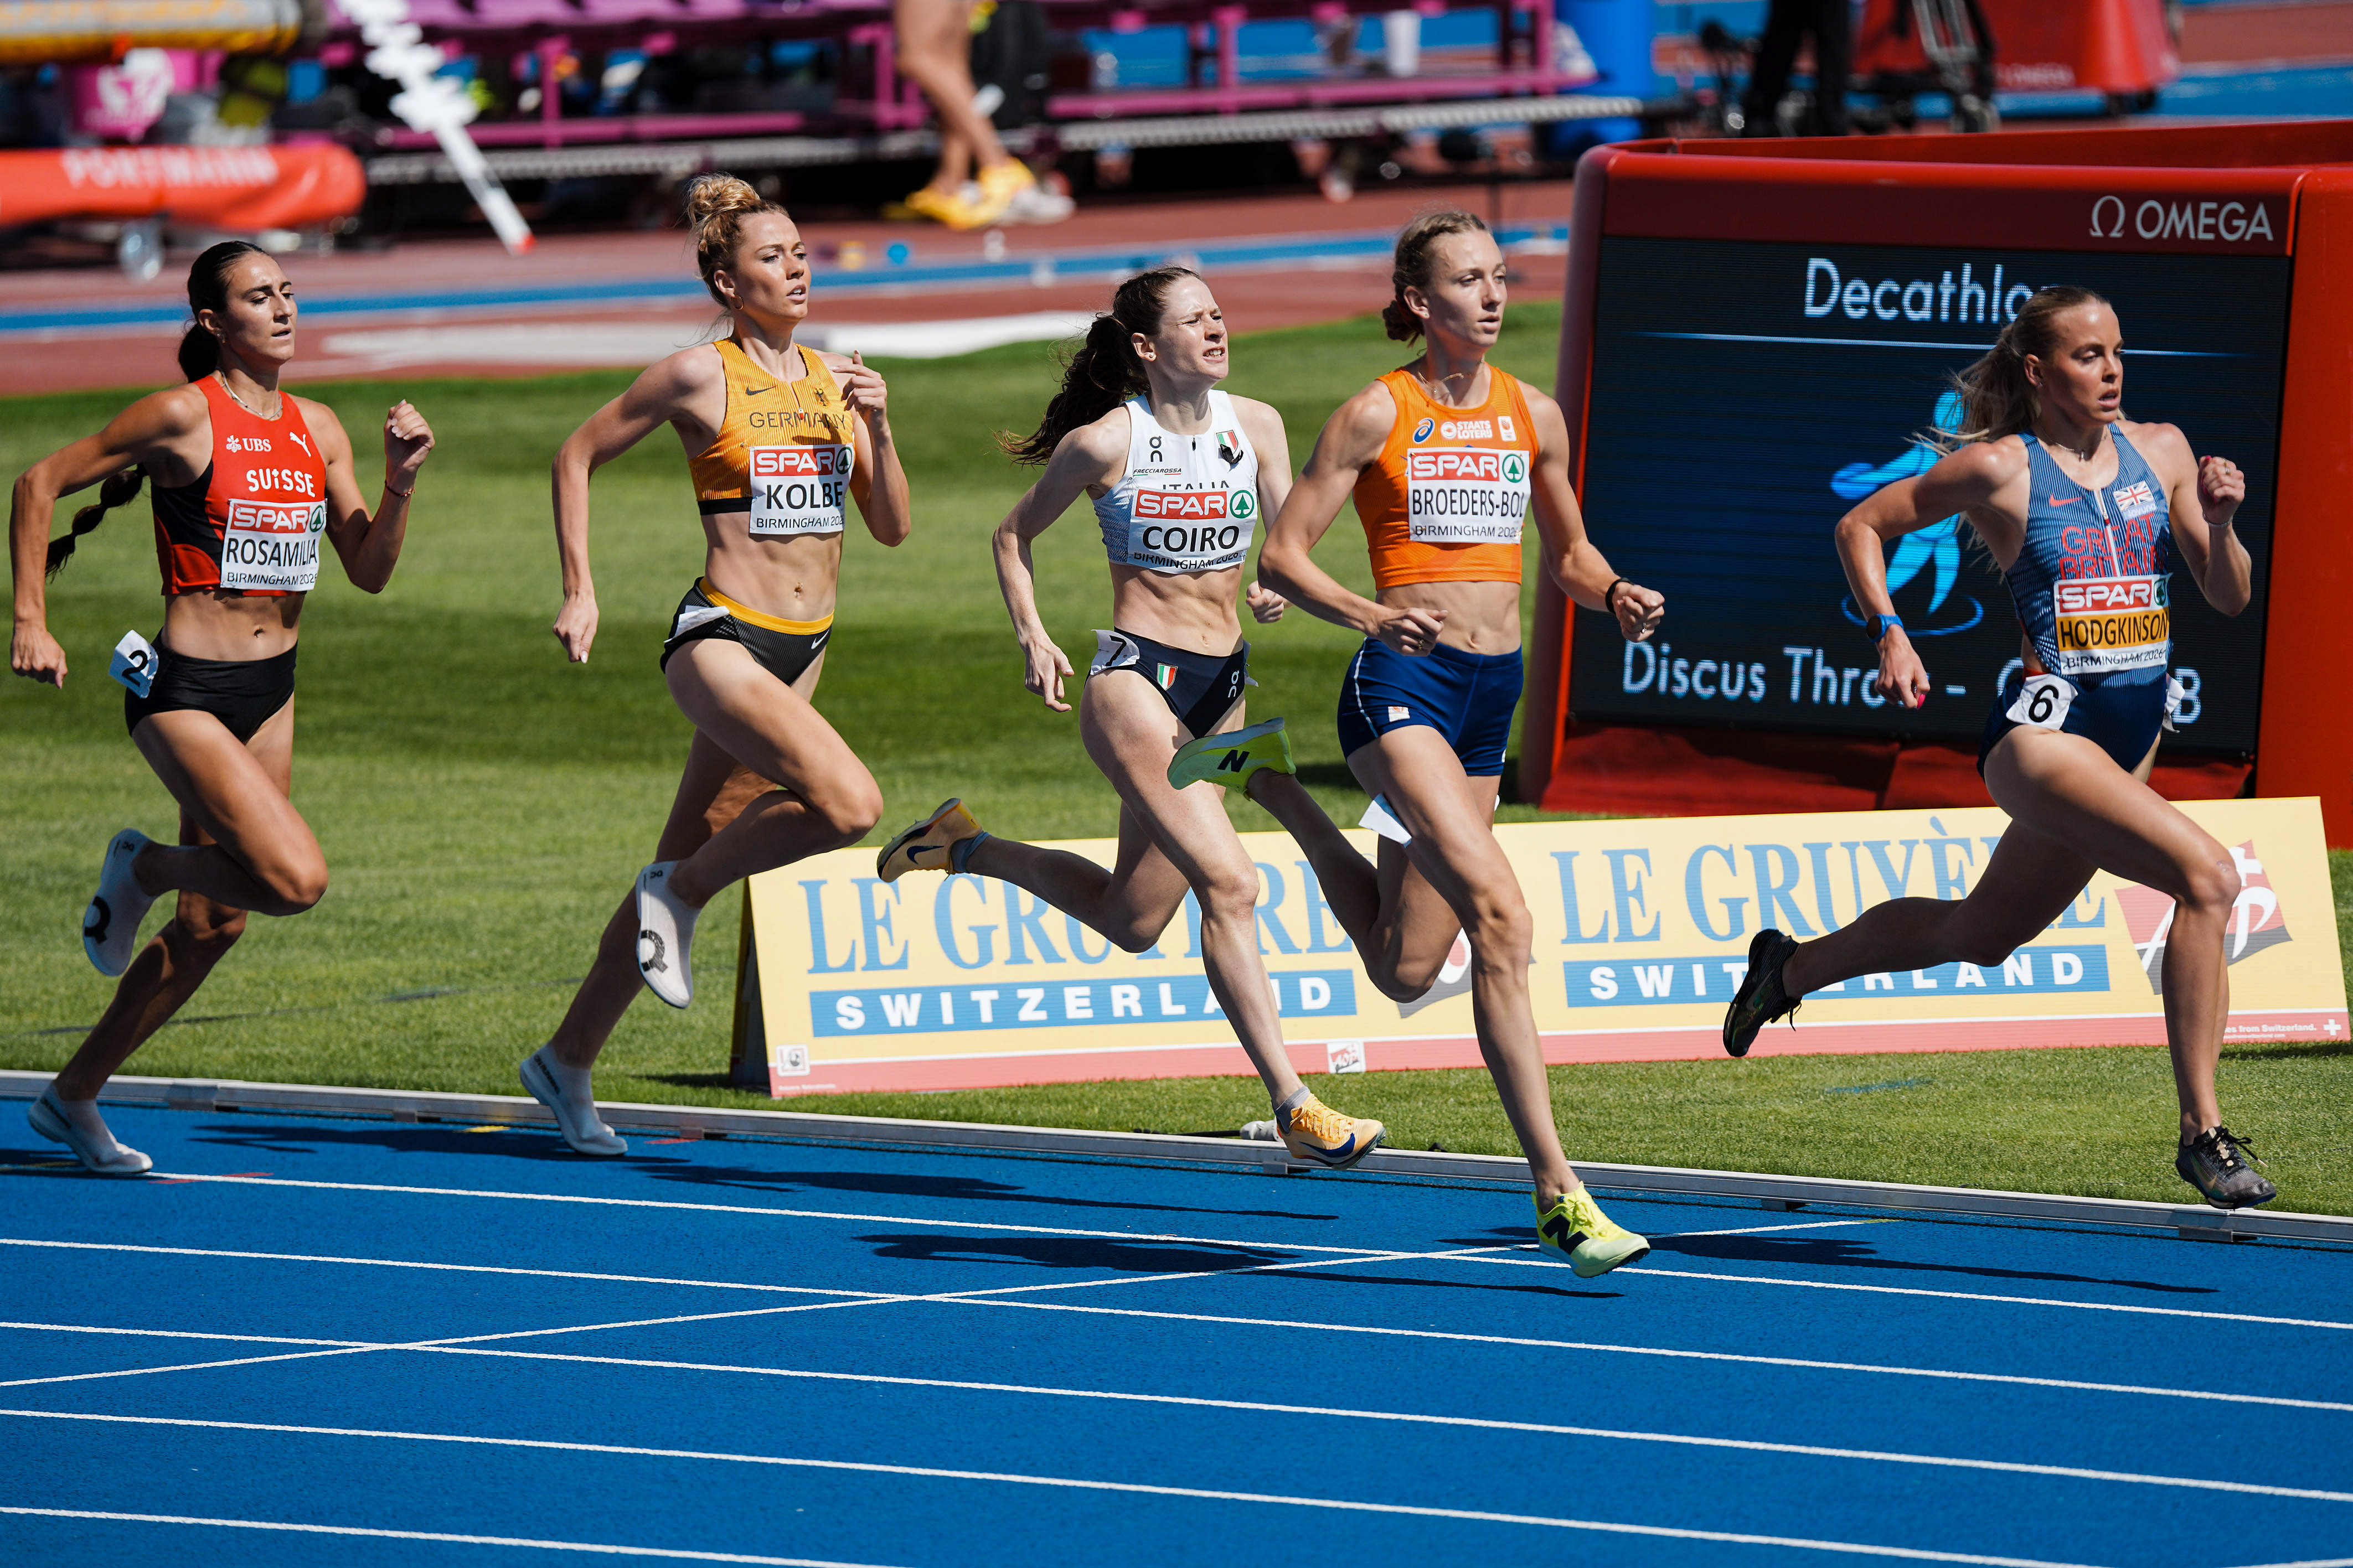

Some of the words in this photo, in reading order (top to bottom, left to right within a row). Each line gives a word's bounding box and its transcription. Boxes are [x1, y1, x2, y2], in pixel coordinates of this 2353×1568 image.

[2135, 199, 2274, 241] OMEGA
[1804, 257, 2060, 323] Decathlo
[750, 412, 846, 430] GERMANY
[1457, 421, 1491, 429] STAATS
[242, 438, 272, 452] UBS
[757, 451, 833, 473] SPAR
[1413, 454, 1498, 478] SPAR
[766, 481, 843, 509] KOLBE
[1138, 494, 1225, 516] SPAR
[234, 506, 309, 530] SPAR
[757, 516, 829, 528] BIRMINGHAM
[1143, 526, 1239, 552] COIRO
[1415, 525, 1495, 537] BIRMINGHAM
[2061, 513, 2154, 554] GREAT
[226, 538, 317, 567] ROSAMILIA
[1134, 552, 1214, 570] BIRMINGHAM
[227, 572, 300, 586] BIRMINGHAM
[2062, 584, 2150, 609] SPAR
[2060, 609, 2168, 649] HODGKINSON
[1106, 635, 1127, 667] 7
[2067, 653, 2143, 668] BIRMINGHAM
[2144, 649, 2163, 661] 2026
[121, 650, 149, 687] 2
[1622, 640, 1767, 703] Discus
[2028, 685, 2059, 723] 6
[1550, 848, 1661, 944] LE
[798, 877, 909, 974] LE
[2262, 1023, 2317, 1032] Switzerland.
